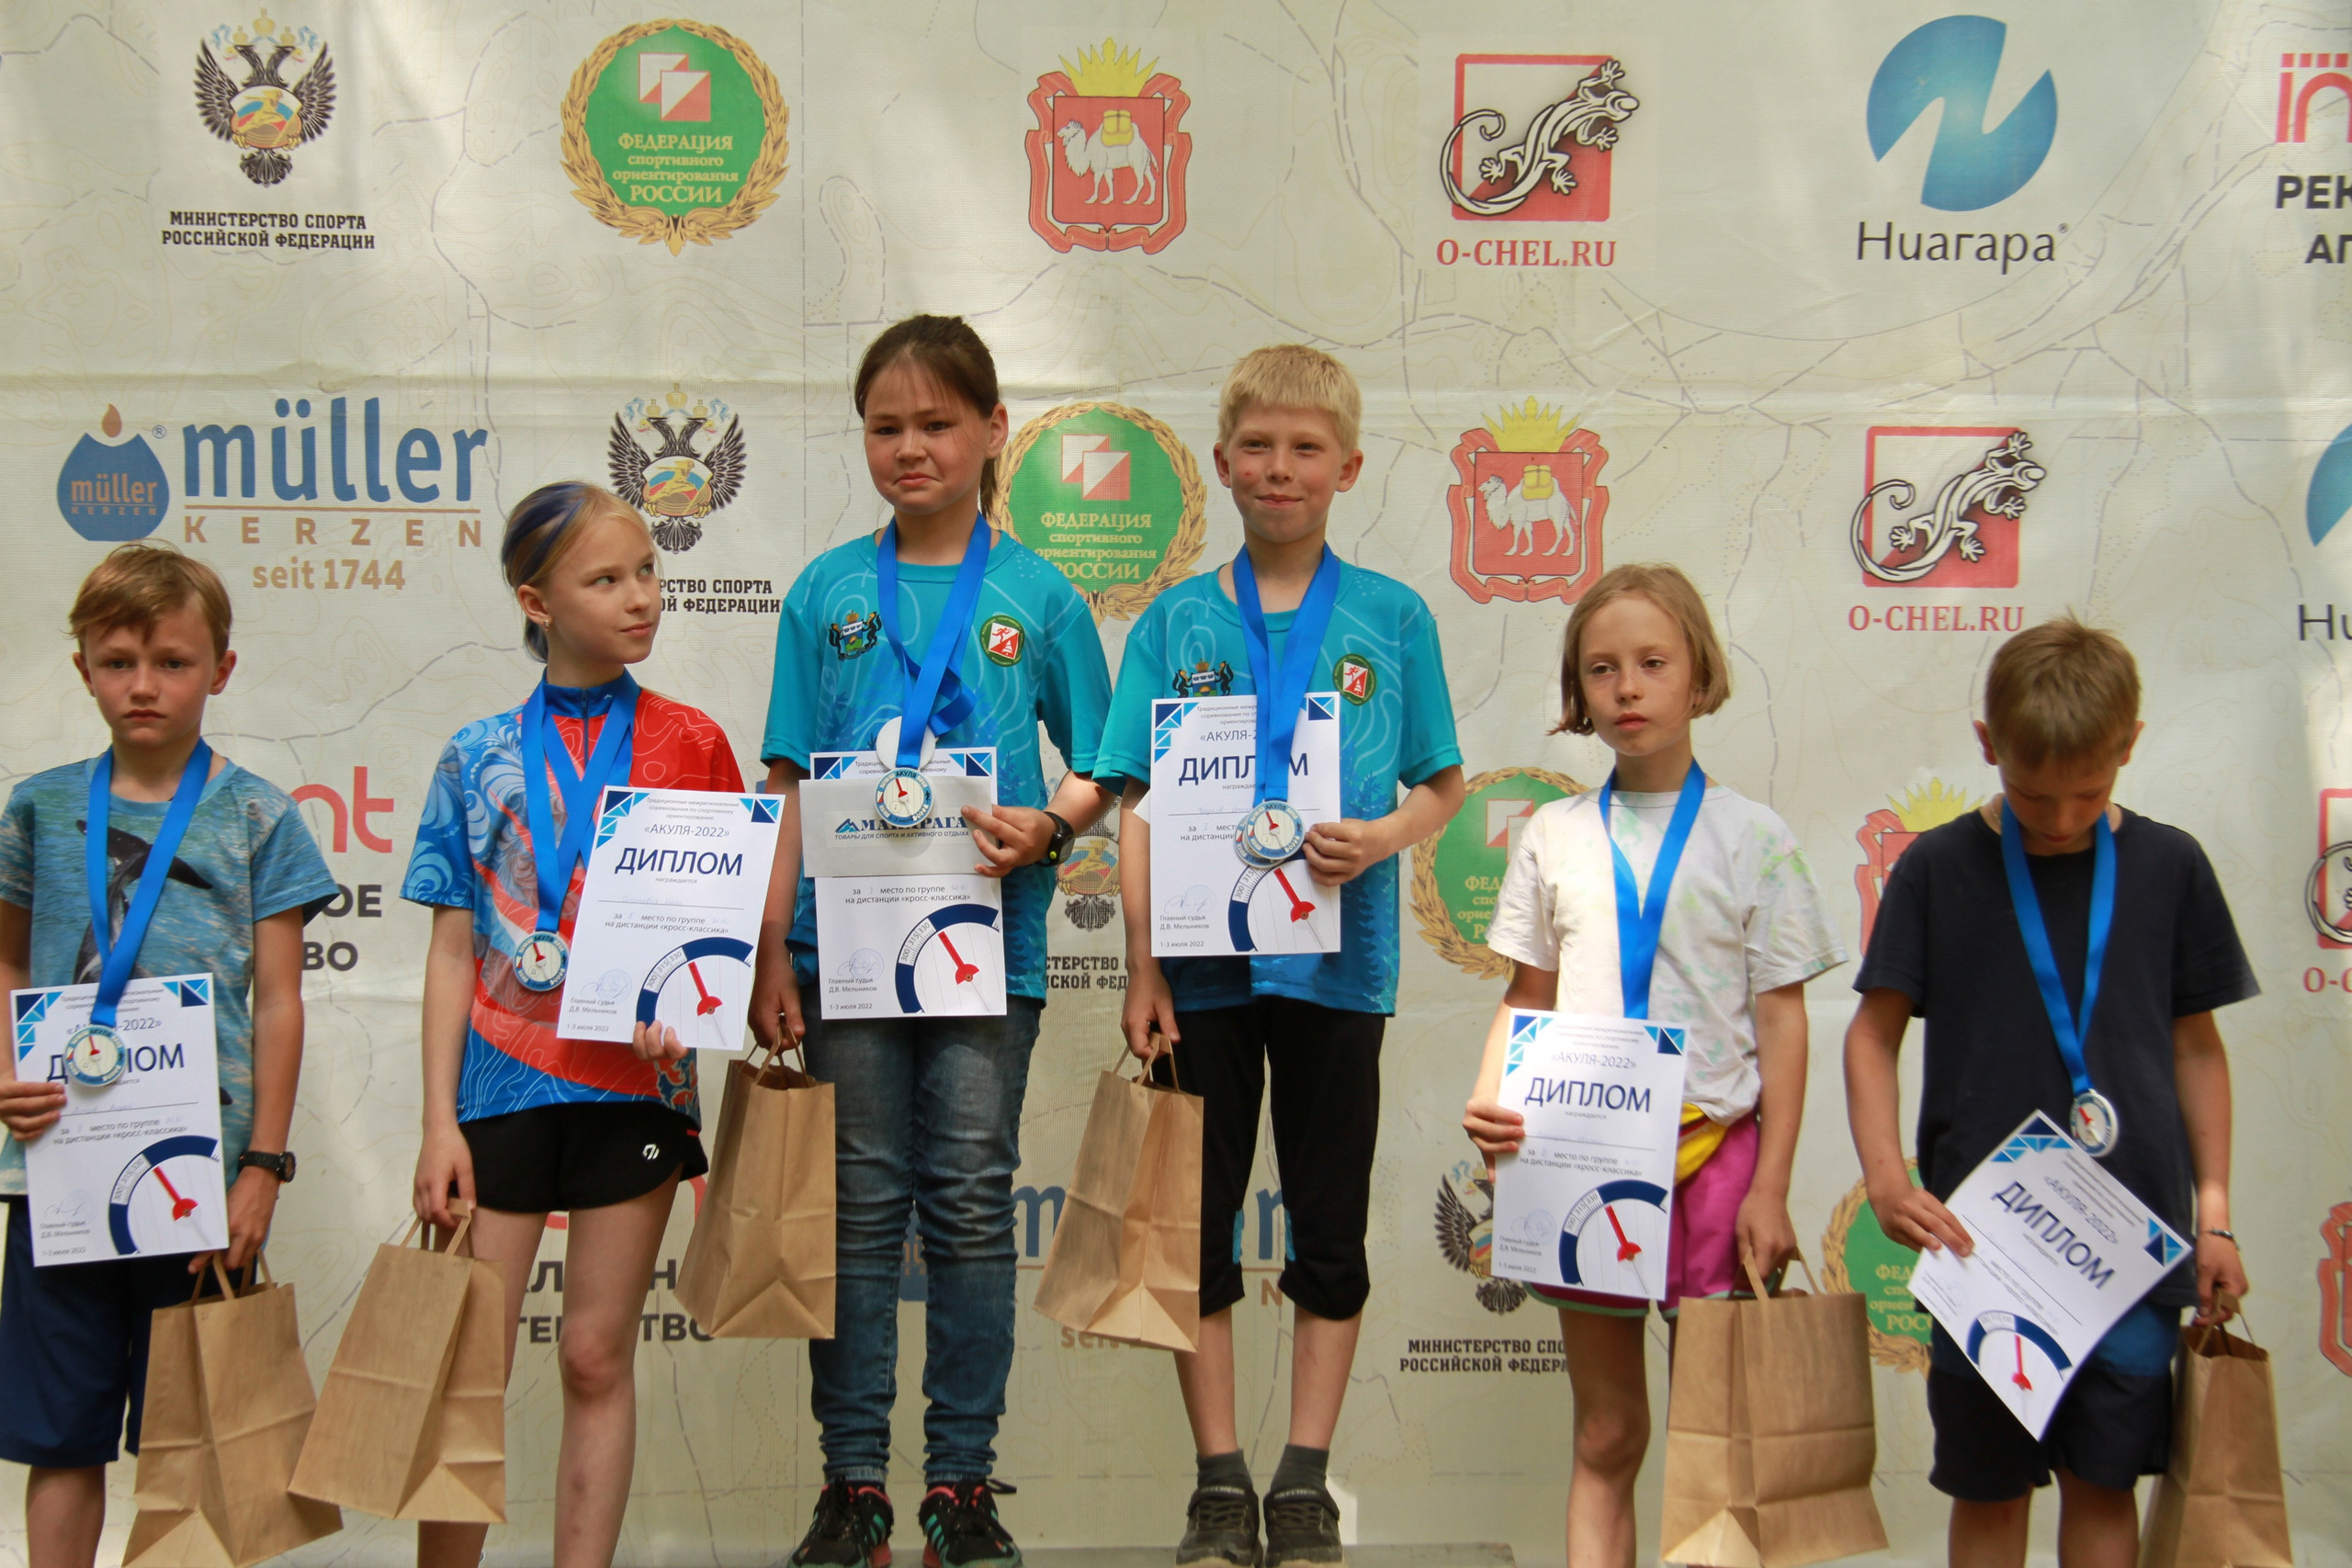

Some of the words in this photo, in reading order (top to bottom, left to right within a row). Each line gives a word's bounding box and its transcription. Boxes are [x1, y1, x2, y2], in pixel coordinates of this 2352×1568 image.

[617, 132, 733, 154] ФЕДЕРАЦИЯ
[627, 155, 724, 169] спортивного
[612, 170, 739, 184] ориентирования
[629, 185, 723, 203] РОССИИ
[169, 210, 299, 228] МИНИСТЕРСТВО
[305, 214, 367, 229] СПОРТА
[162, 229, 269, 246] РОССИЙСКОЙ
[276, 232, 375, 250] ФЕДЕРАЦИИ
[1436, 239, 1617, 266] O-CHEL.RU
[183, 396, 488, 503] müller
[71, 472, 158, 502] müller
[1040, 512, 1152, 532] ФЕДЕРАЦИЯ
[184, 515, 481, 547] KERZEN
[1049, 534, 1143, 547] спортивного
[253, 557, 314, 590] seit
[323, 558, 406, 592] 1744
[713, 580, 773, 594] СПОРТА
[684, 598, 781, 615] ФЕДЕРАЦИИ
[1849, 605, 2025, 632] O-CHEL.RU
[1179, 753, 1308, 786] ДИПЛМ
[644, 823, 730, 838] «АКУЛЯ-2022»
[614, 847, 743, 876] ДИПЛОМ
[917, 886, 945, 895] группе
[856, 896, 899, 905] дистанции
[900, 895, 971, 903] «кросс-классика»
[615, 921, 659, 931] дистанции
[660, 924, 729, 934] «кросс-классика»
[677, 917, 706, 925] группе
[918, 921, 931, 934] 330
[908, 933, 920, 946] 315
[669, 951, 683, 963] 330
[900, 949, 910, 962] 300
[656, 960, 669, 974] 315
[646, 975, 658, 988] 300
[1524, 1077, 1651, 1113] ДИПЛОМ
[1990, 1179, 2116, 1290] ДИПЛОМ
[1408, 1338, 1532, 1353] МИНИСТЕРСТВО
[1399, 1355, 1502, 1372] РОССИЙСКОЙ
